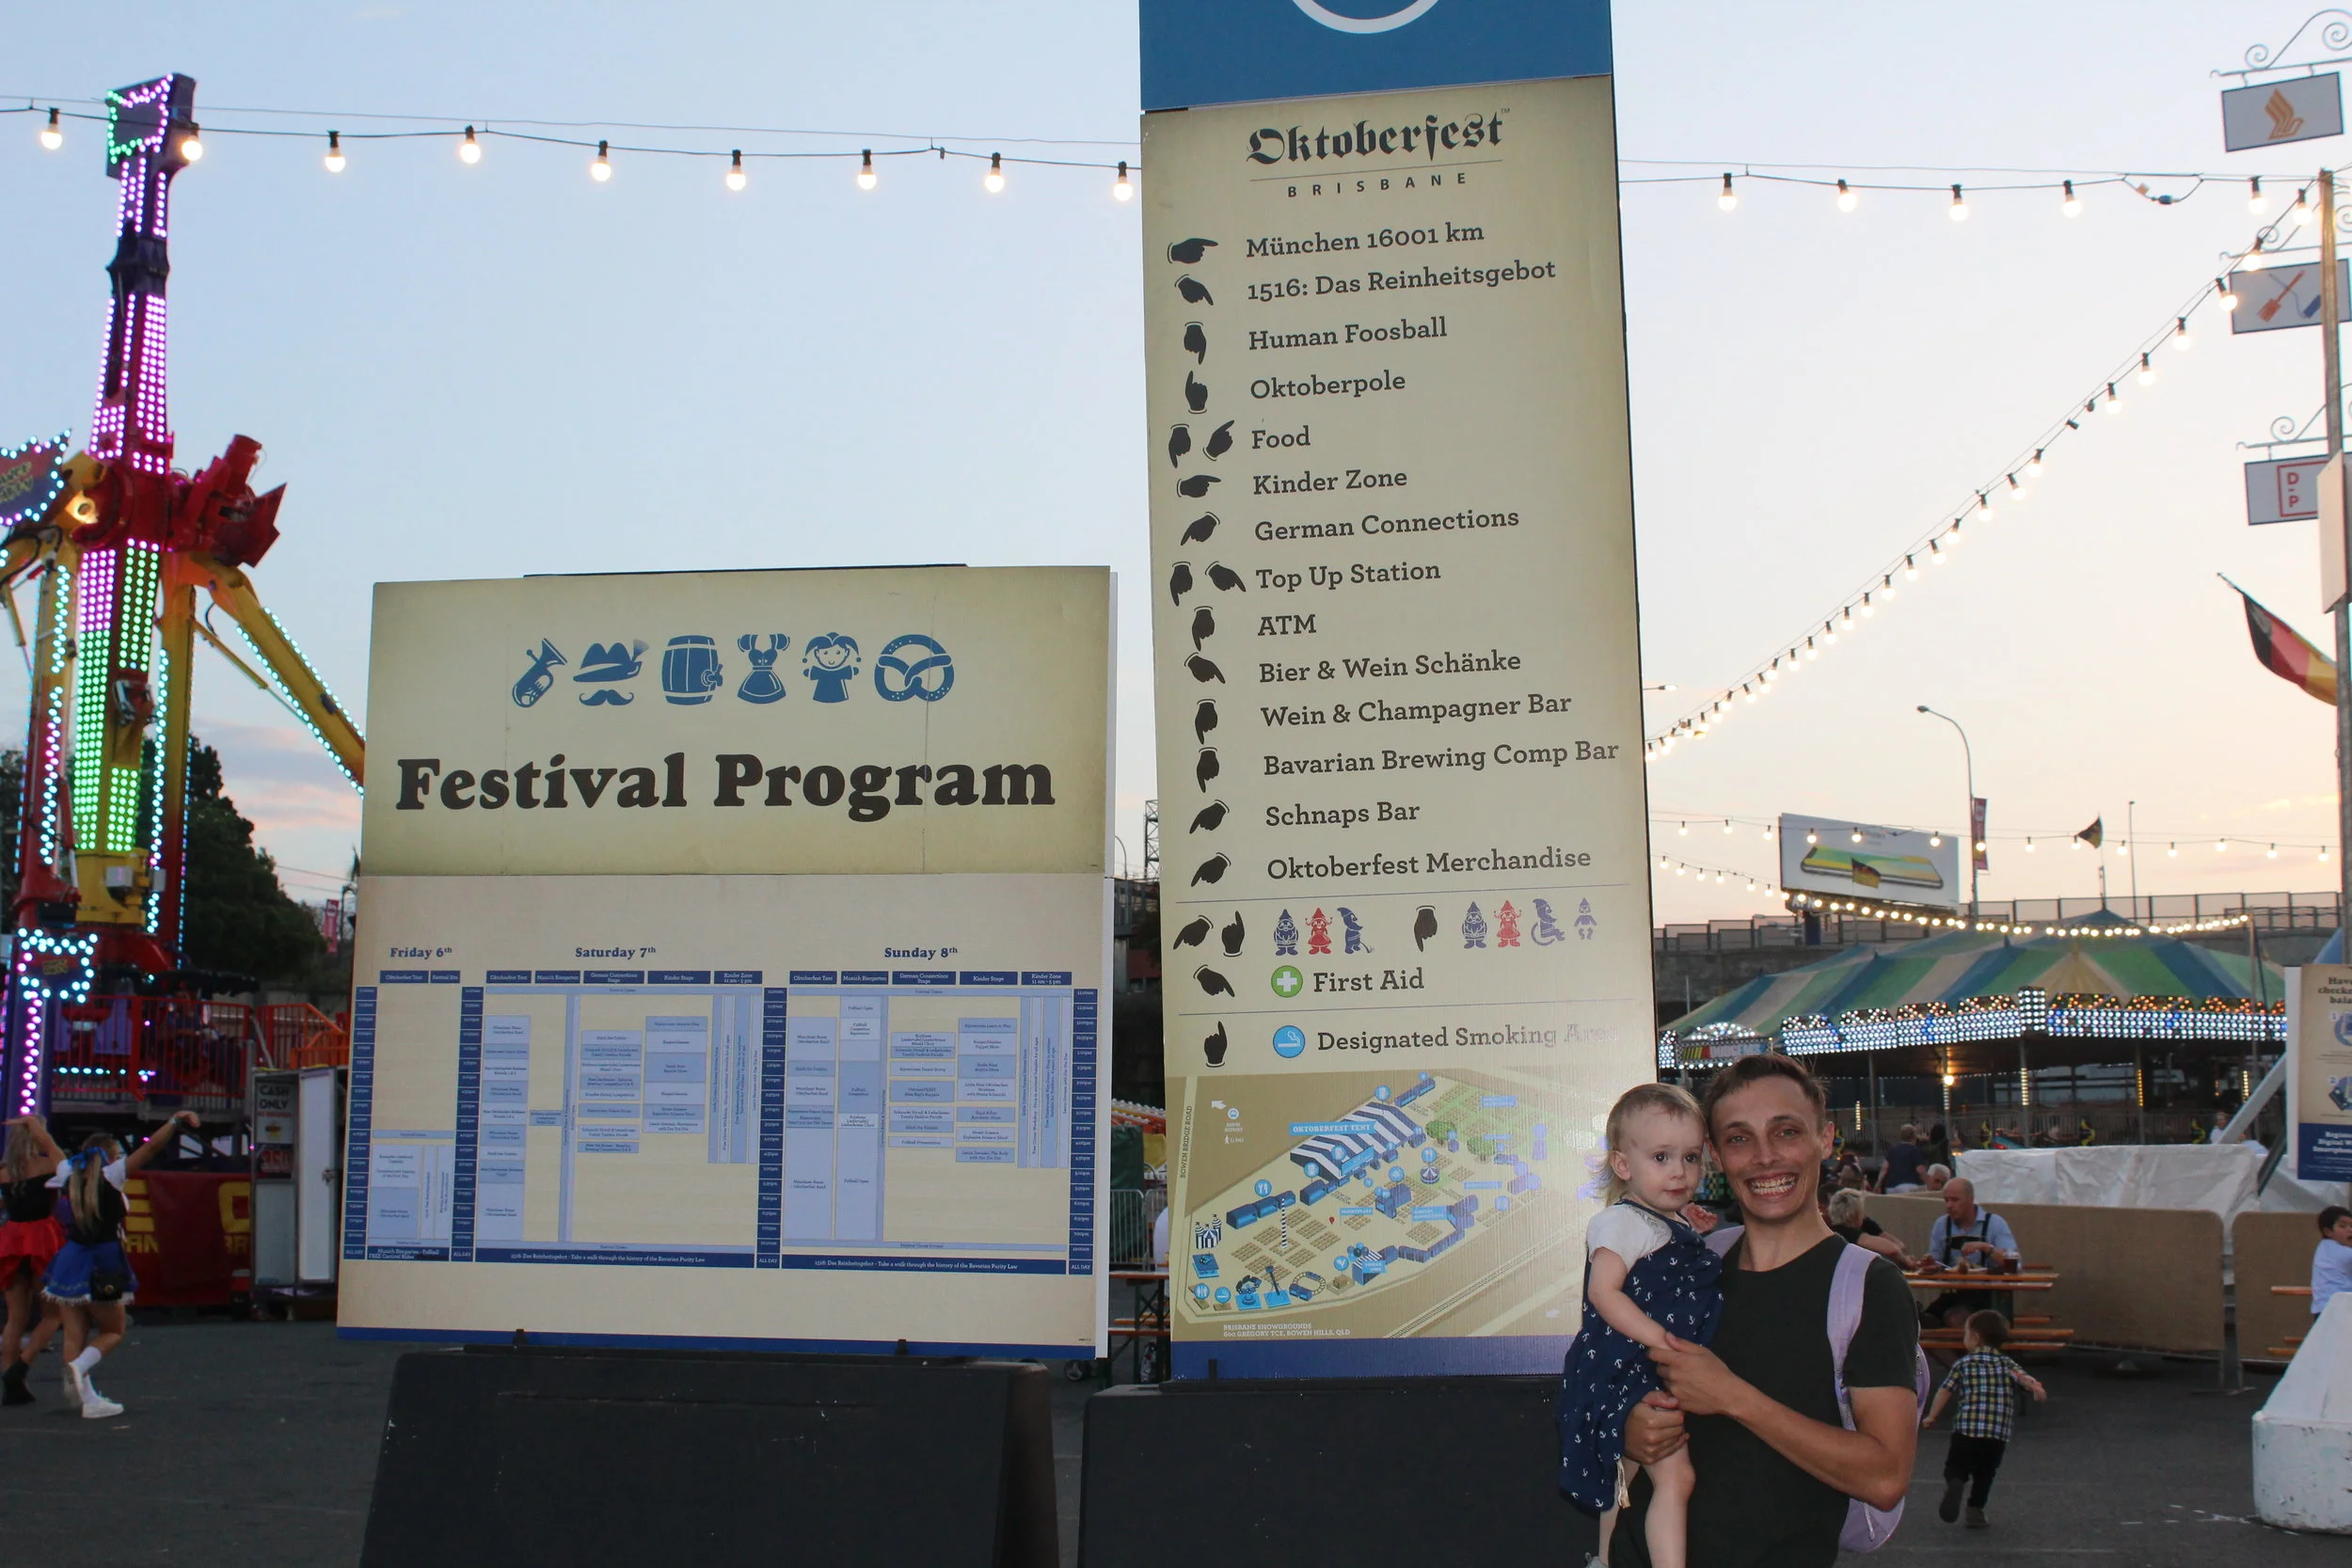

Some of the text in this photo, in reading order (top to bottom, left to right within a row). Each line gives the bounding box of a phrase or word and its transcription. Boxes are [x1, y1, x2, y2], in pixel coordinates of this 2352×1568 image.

[1246, 111, 1503, 165] Oktoberfest
[1288, 173, 1468, 198] BRISBANE
[1247, 222, 1484, 257] München 16001 km
[1248, 260, 1555, 302] 1516: Das Reinheitsgebot
[1249, 316, 1447, 350] Human Foosball
[1251, 370, 1405, 399] Oktoberpole
[1252, 425, 1311, 449] Food
[1253, 469, 1406, 495] Kinder Zone
[1255, 510, 1518, 541] German Connections
[1256, 562, 1440, 593] Top Up Station
[1258, 614, 1316, 636] ATM
[1260, 649, 1520, 682] Bier & Wein Schänke
[1261, 694, 1571, 726] Wein & Champagner Bar
[1264, 741, 1618, 775] Bavarian Brewing Comp Bar
[396, 752, 1056, 822] Festival Program
[1266, 801, 1420, 828] Schnaps Bar
[1268, 847, 1590, 879] Oktoberfest Merchandise
[389, 947, 453, 959] Friday 6th
[575, 946, 657, 960] Saturday 7th
[884, 947, 958, 960] Sunday 8th
[1313, 967, 1424, 992] First Aid
[1318, 1026, 1448, 1053] Designated
[1455, 1024, 1556, 1048] Smoking
[259, 1098, 288, 1110] ONLY
